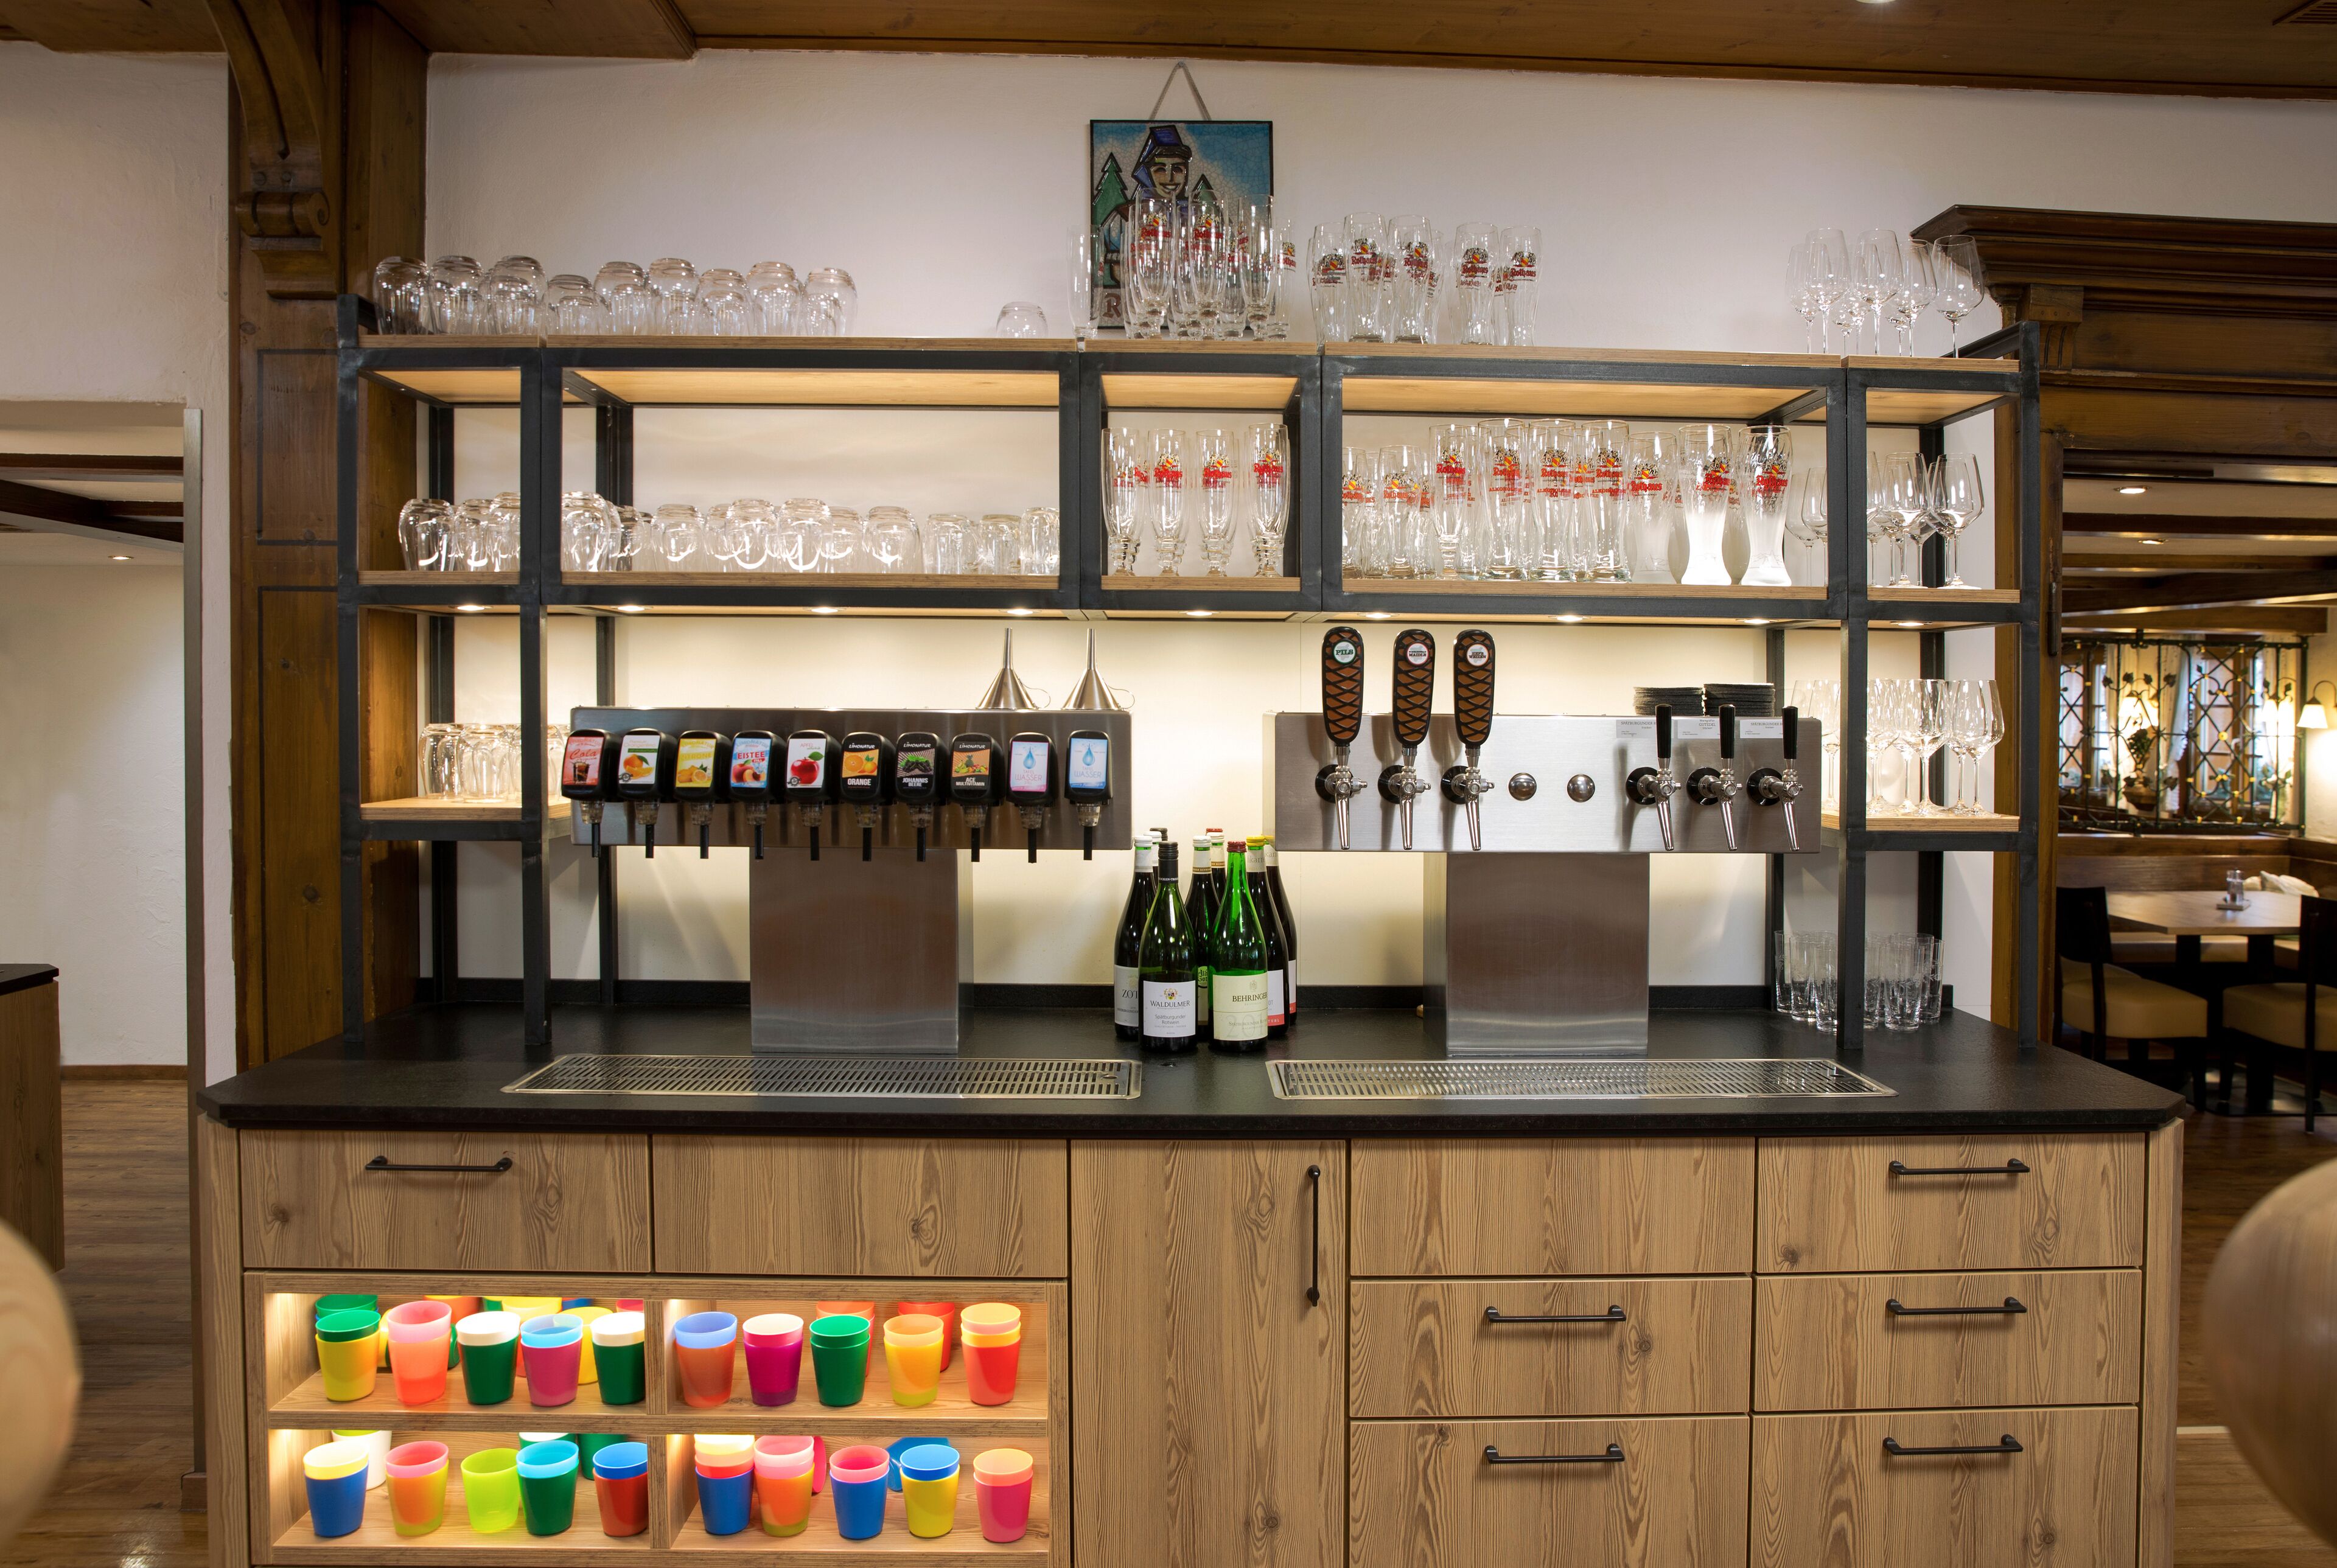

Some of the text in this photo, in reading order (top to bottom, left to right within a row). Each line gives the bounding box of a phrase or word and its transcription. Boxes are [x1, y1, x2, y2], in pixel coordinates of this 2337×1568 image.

[1510, 268, 1536, 277] Rothaus
[1631, 481, 1662, 493] Rothaus
[570, 748, 597, 760] Cola
[738, 751, 765, 759] EISTEE
[1015, 773, 1043, 782] WASSER
[1074, 770, 1102, 779] WASSER
